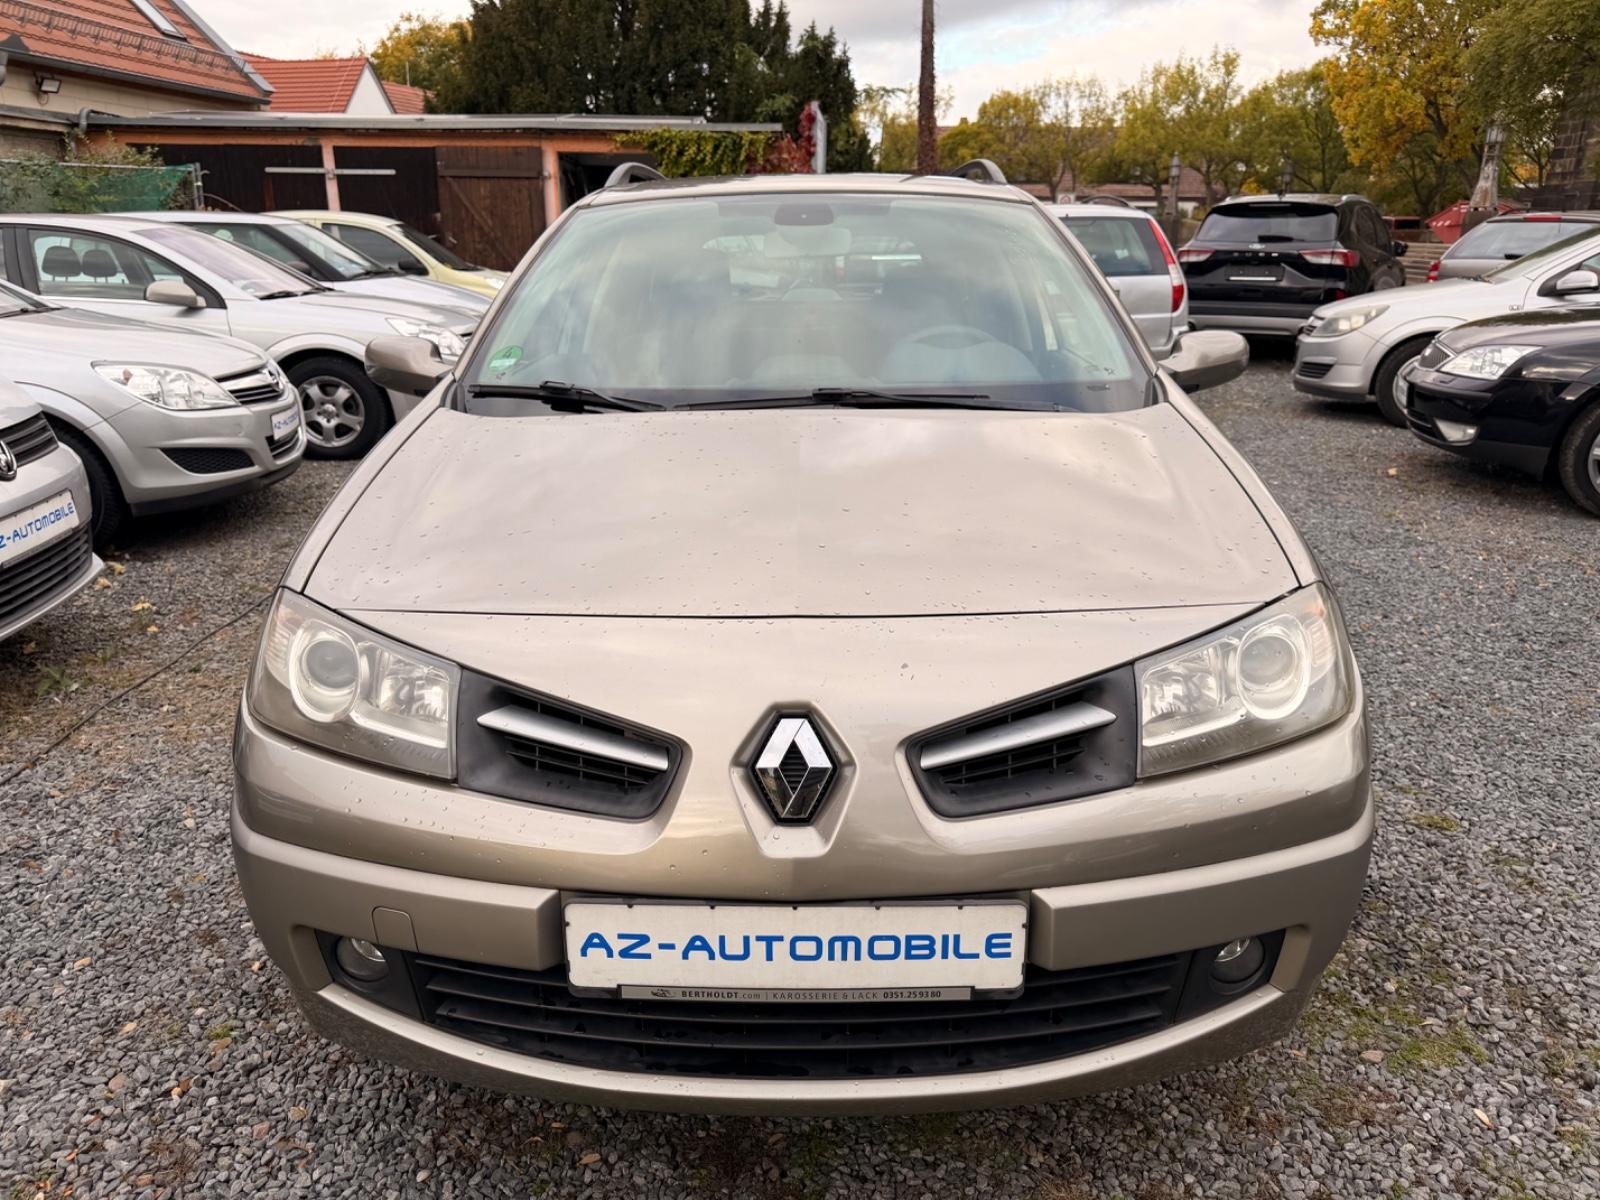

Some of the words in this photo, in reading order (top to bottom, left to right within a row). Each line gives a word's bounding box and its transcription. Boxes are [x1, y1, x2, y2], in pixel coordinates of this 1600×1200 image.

[580, 932, 1012, 961] AZ-AUTOMOBILE
[681, 990, 761, 1000] BERTHOLDT.com
[772, 991, 838, 1000] KAROSSERIE
[841, 992, 848, 1000] &
[852, 991, 878, 1000] LACK
